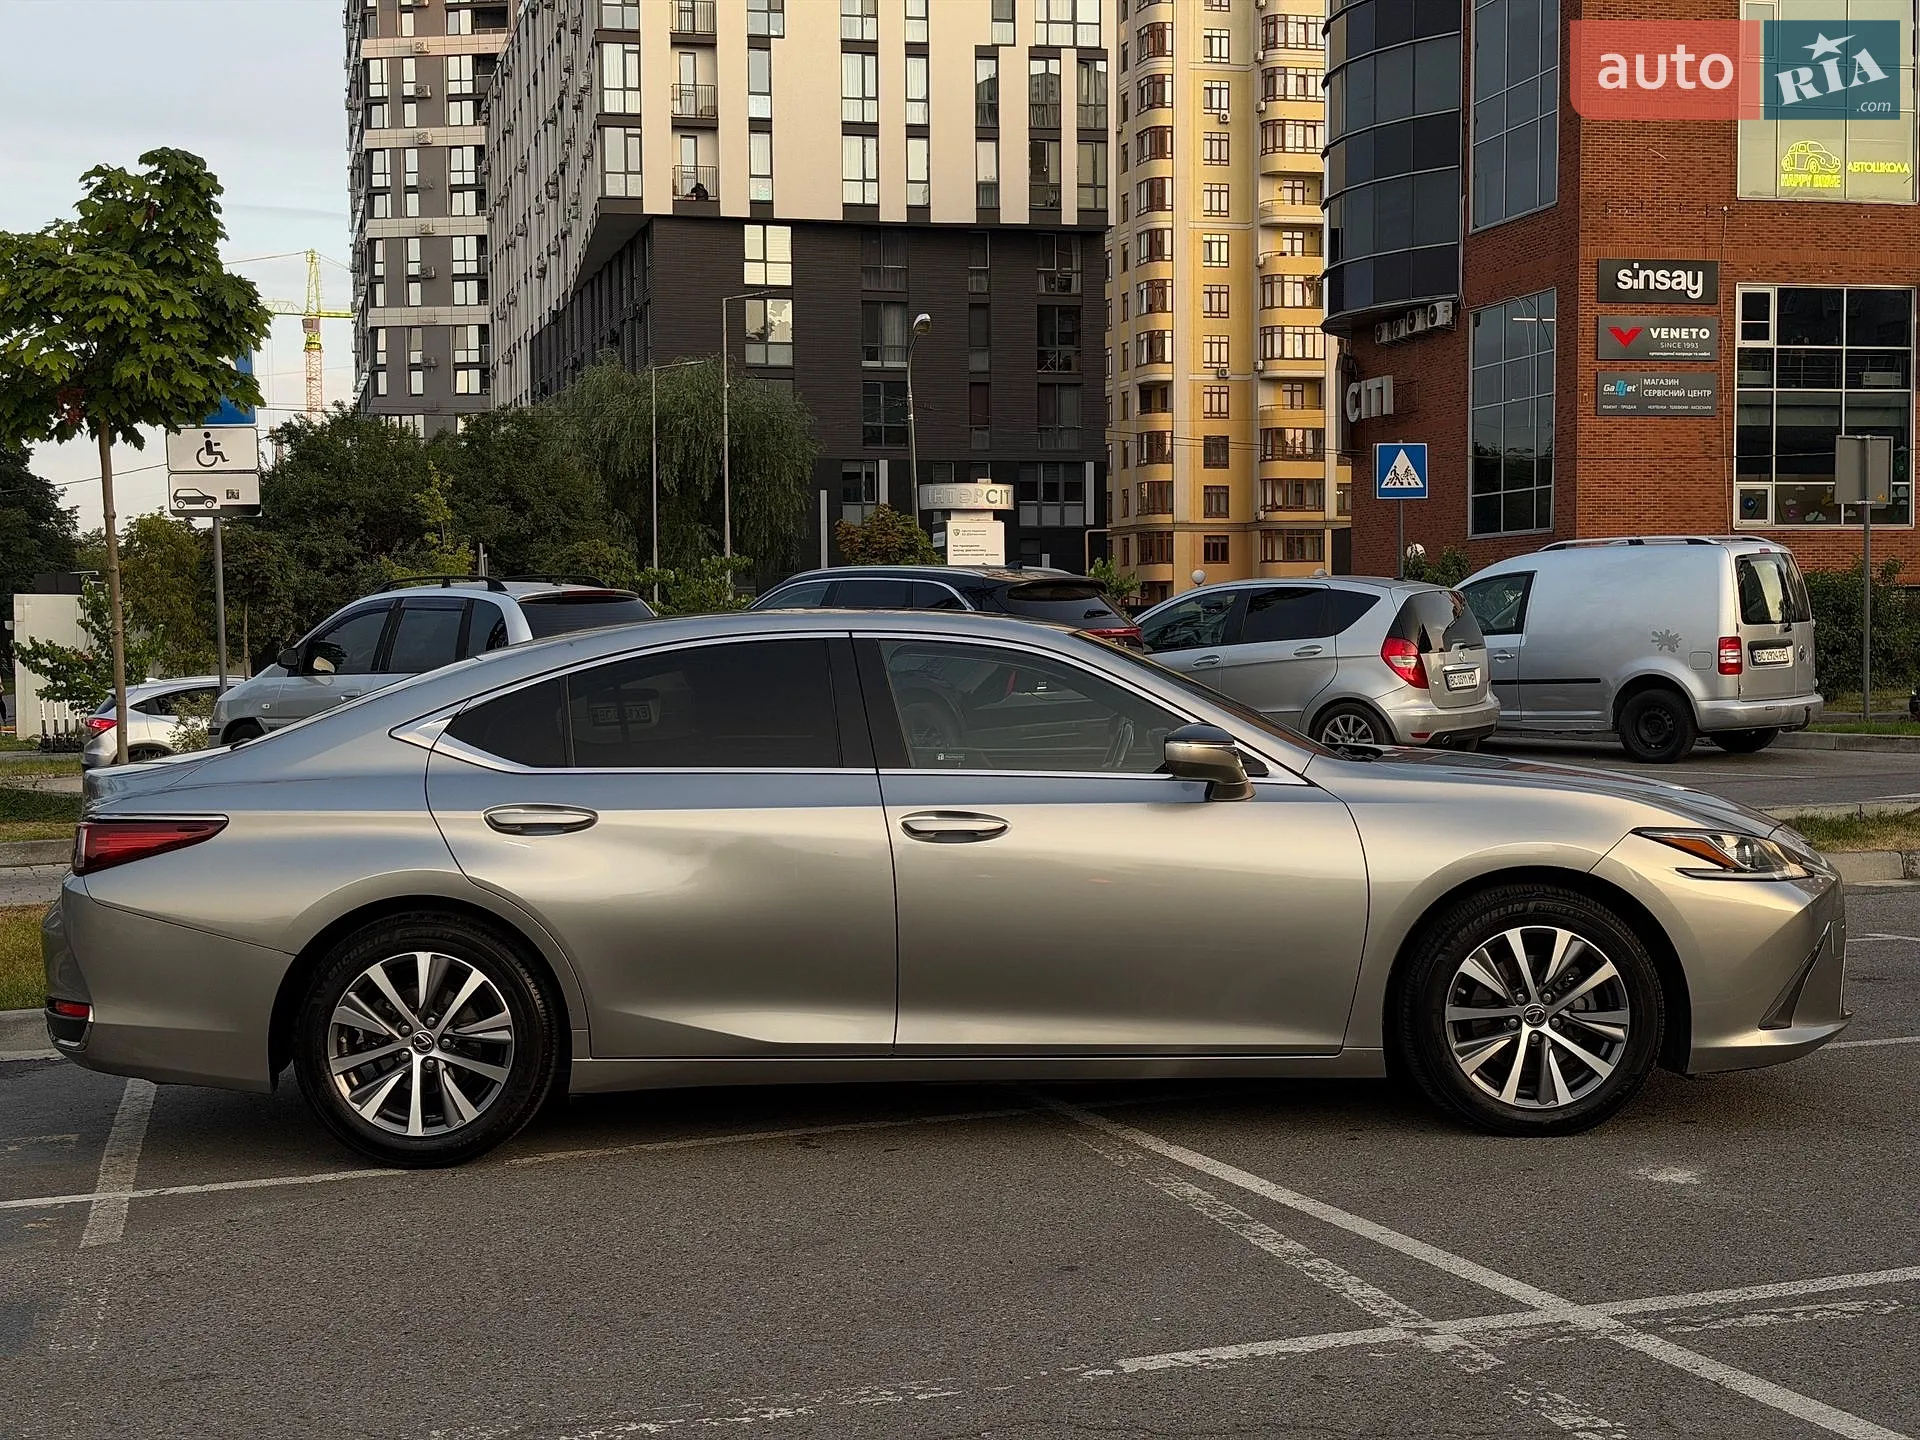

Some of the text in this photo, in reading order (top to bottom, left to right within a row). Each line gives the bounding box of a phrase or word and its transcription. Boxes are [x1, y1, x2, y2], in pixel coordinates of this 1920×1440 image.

[1847, 161, 1911, 174] АВТОШКОЛА
[1781, 173, 1812, 187] HAPPY
[1616, 263, 1703, 299] sinsay
[1649, 327, 1711, 339] VENETO
[1683, 341, 1699, 349] 1993
[1643, 378, 1680, 386] МАГАЗИН
[1643, 388, 1712, 398] СЕРВІСНИЙ ЦЕНТР
